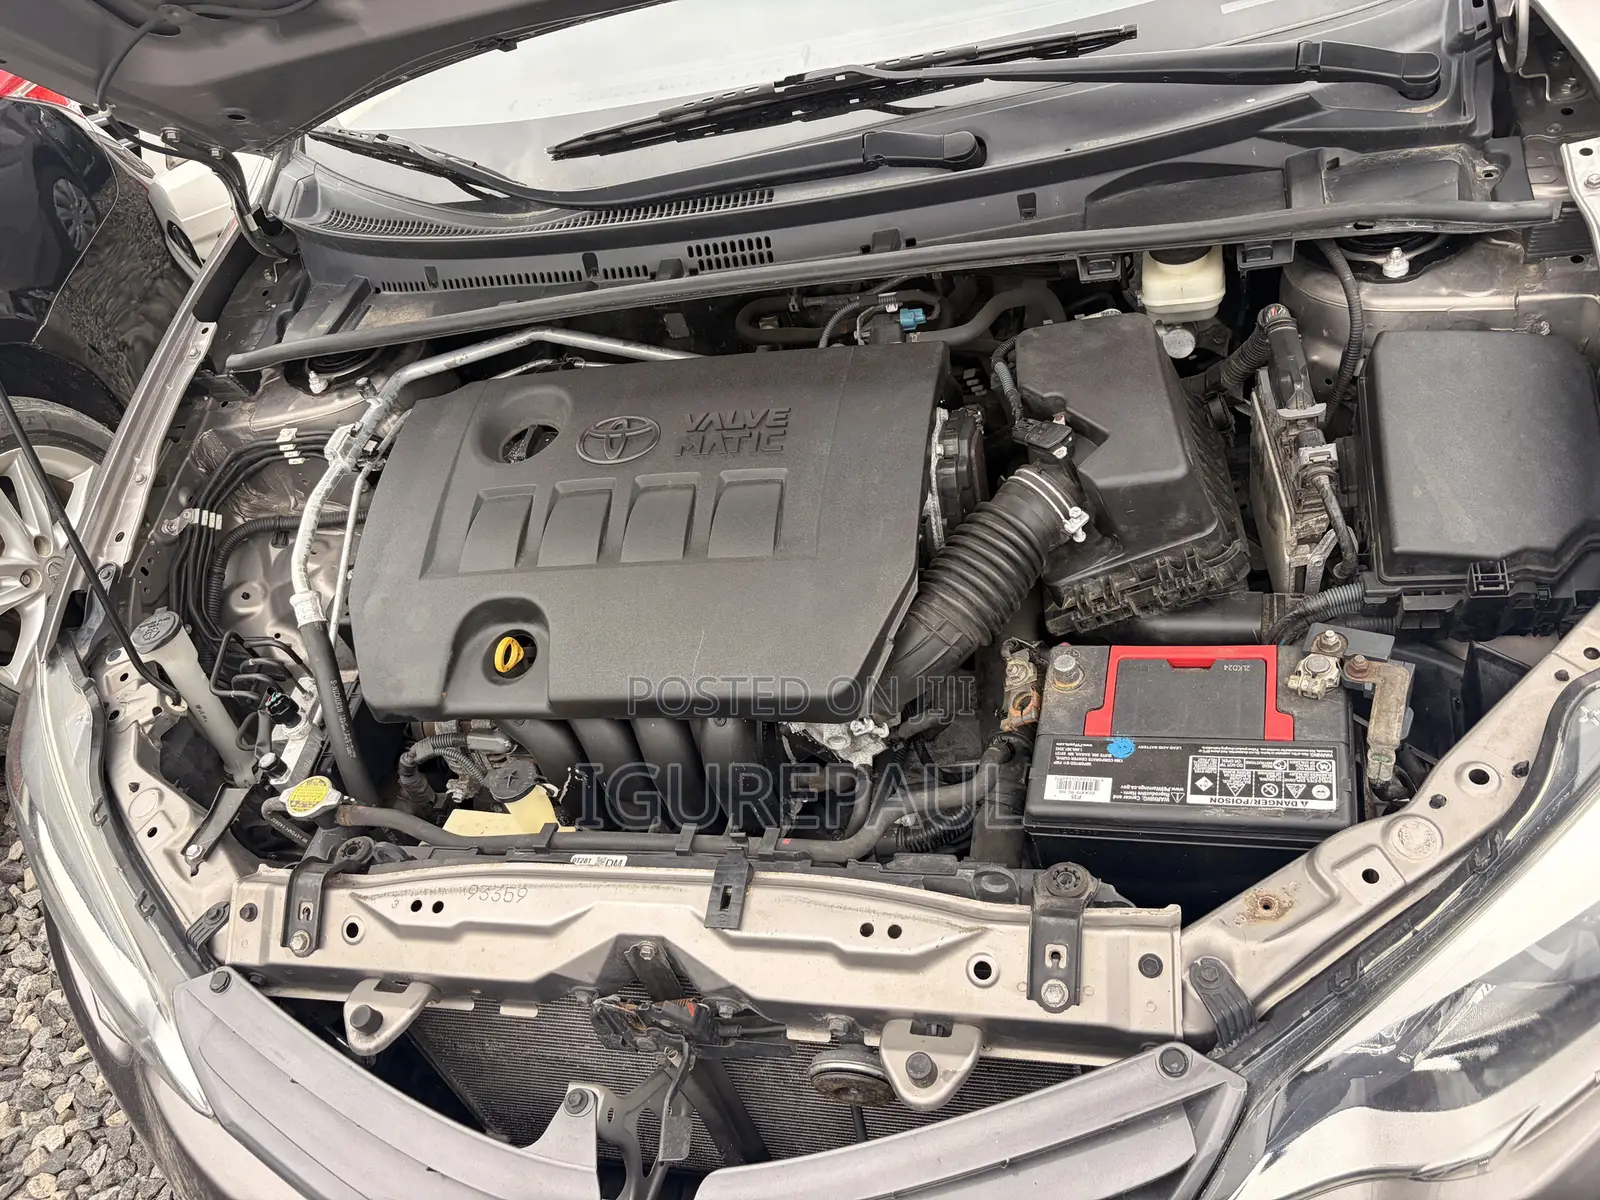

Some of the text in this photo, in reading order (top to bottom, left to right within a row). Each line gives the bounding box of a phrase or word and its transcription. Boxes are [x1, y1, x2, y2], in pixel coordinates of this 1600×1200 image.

[682, 407, 791, 432] VALVE
[674, 430, 786, 457] MATIC
[1210, 797, 1298, 807] DANGER/POISON
[467, 884, 529, 904] 93359
